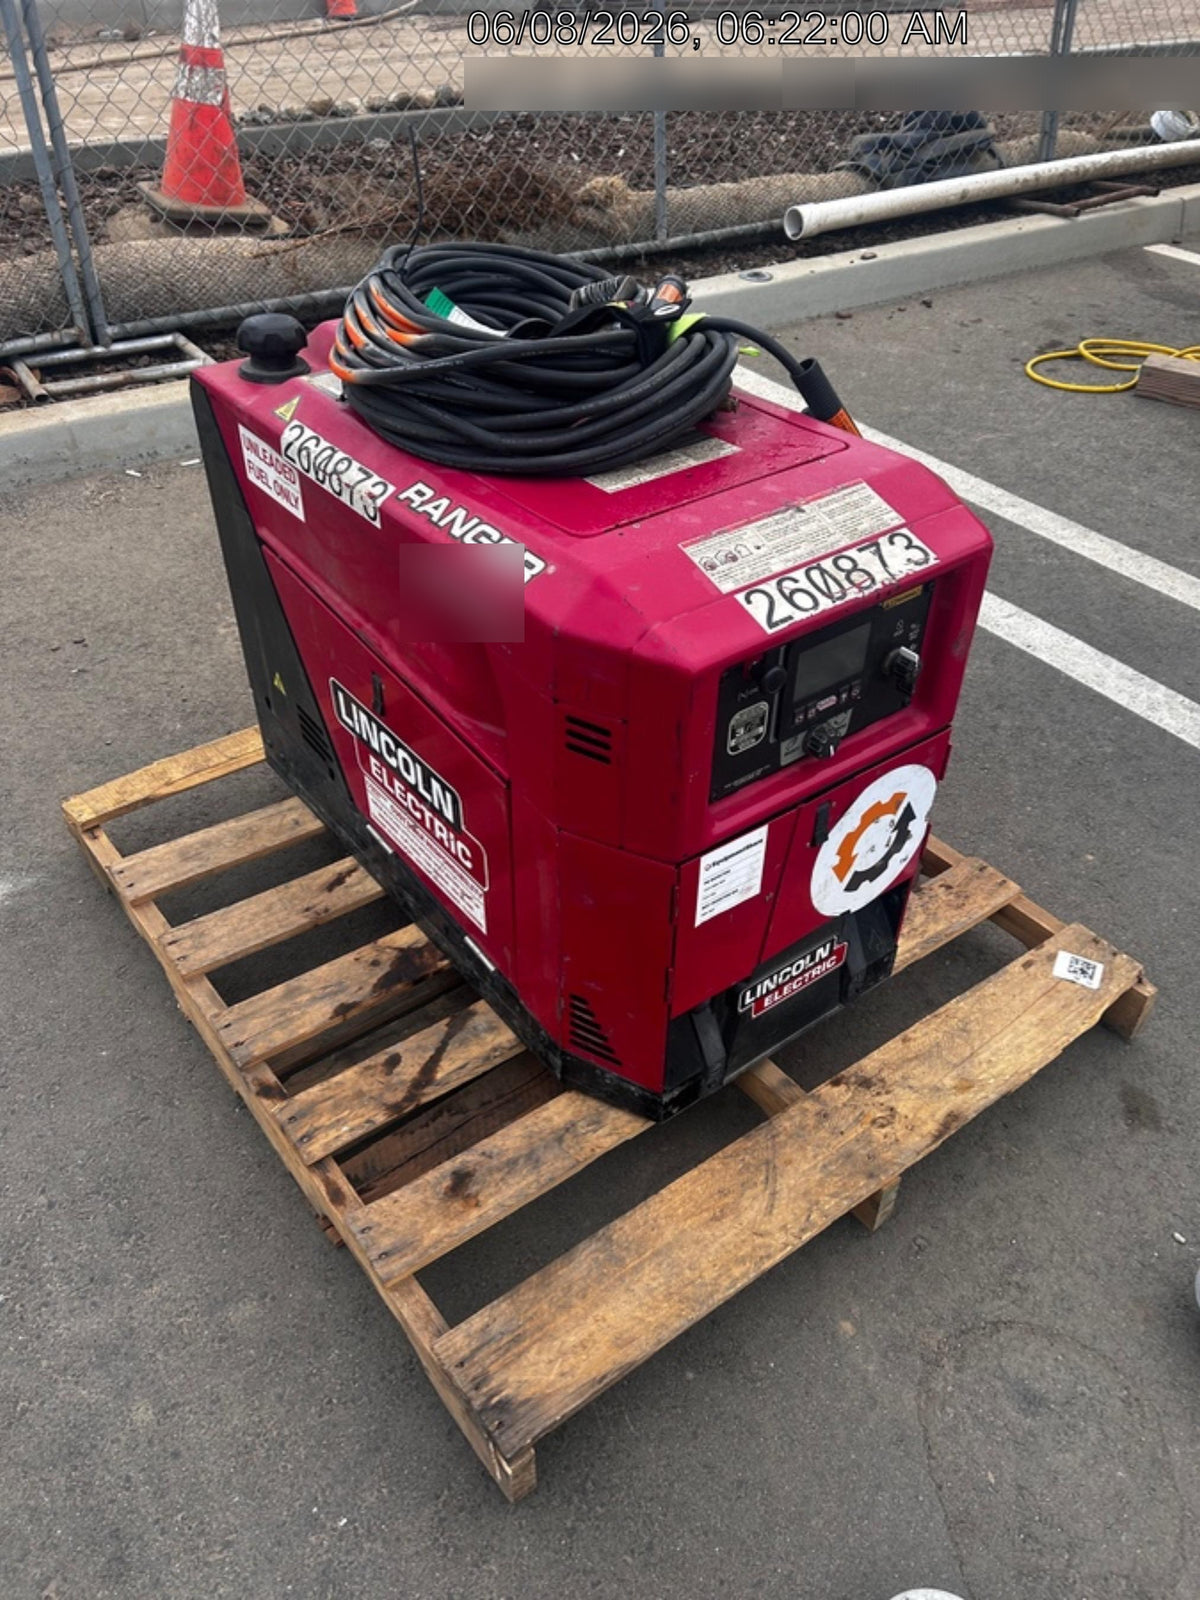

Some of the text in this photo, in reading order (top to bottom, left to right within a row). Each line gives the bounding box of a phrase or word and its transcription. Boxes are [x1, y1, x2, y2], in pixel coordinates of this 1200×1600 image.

[242, 437, 296, 484] UNLEADED
[247, 459, 299, 510] FUEL ONLY
[283, 424, 388, 522] 260873
[398, 481, 547, 583] RANGR
[745, 532, 931, 630] 260873
[337, 690, 455, 823] LINCOLN
[369, 755, 474, 869] ELECTRIC
[745, 942, 831, 1004] LINCOLN
[765, 956, 837, 1007] ELECTRIC
